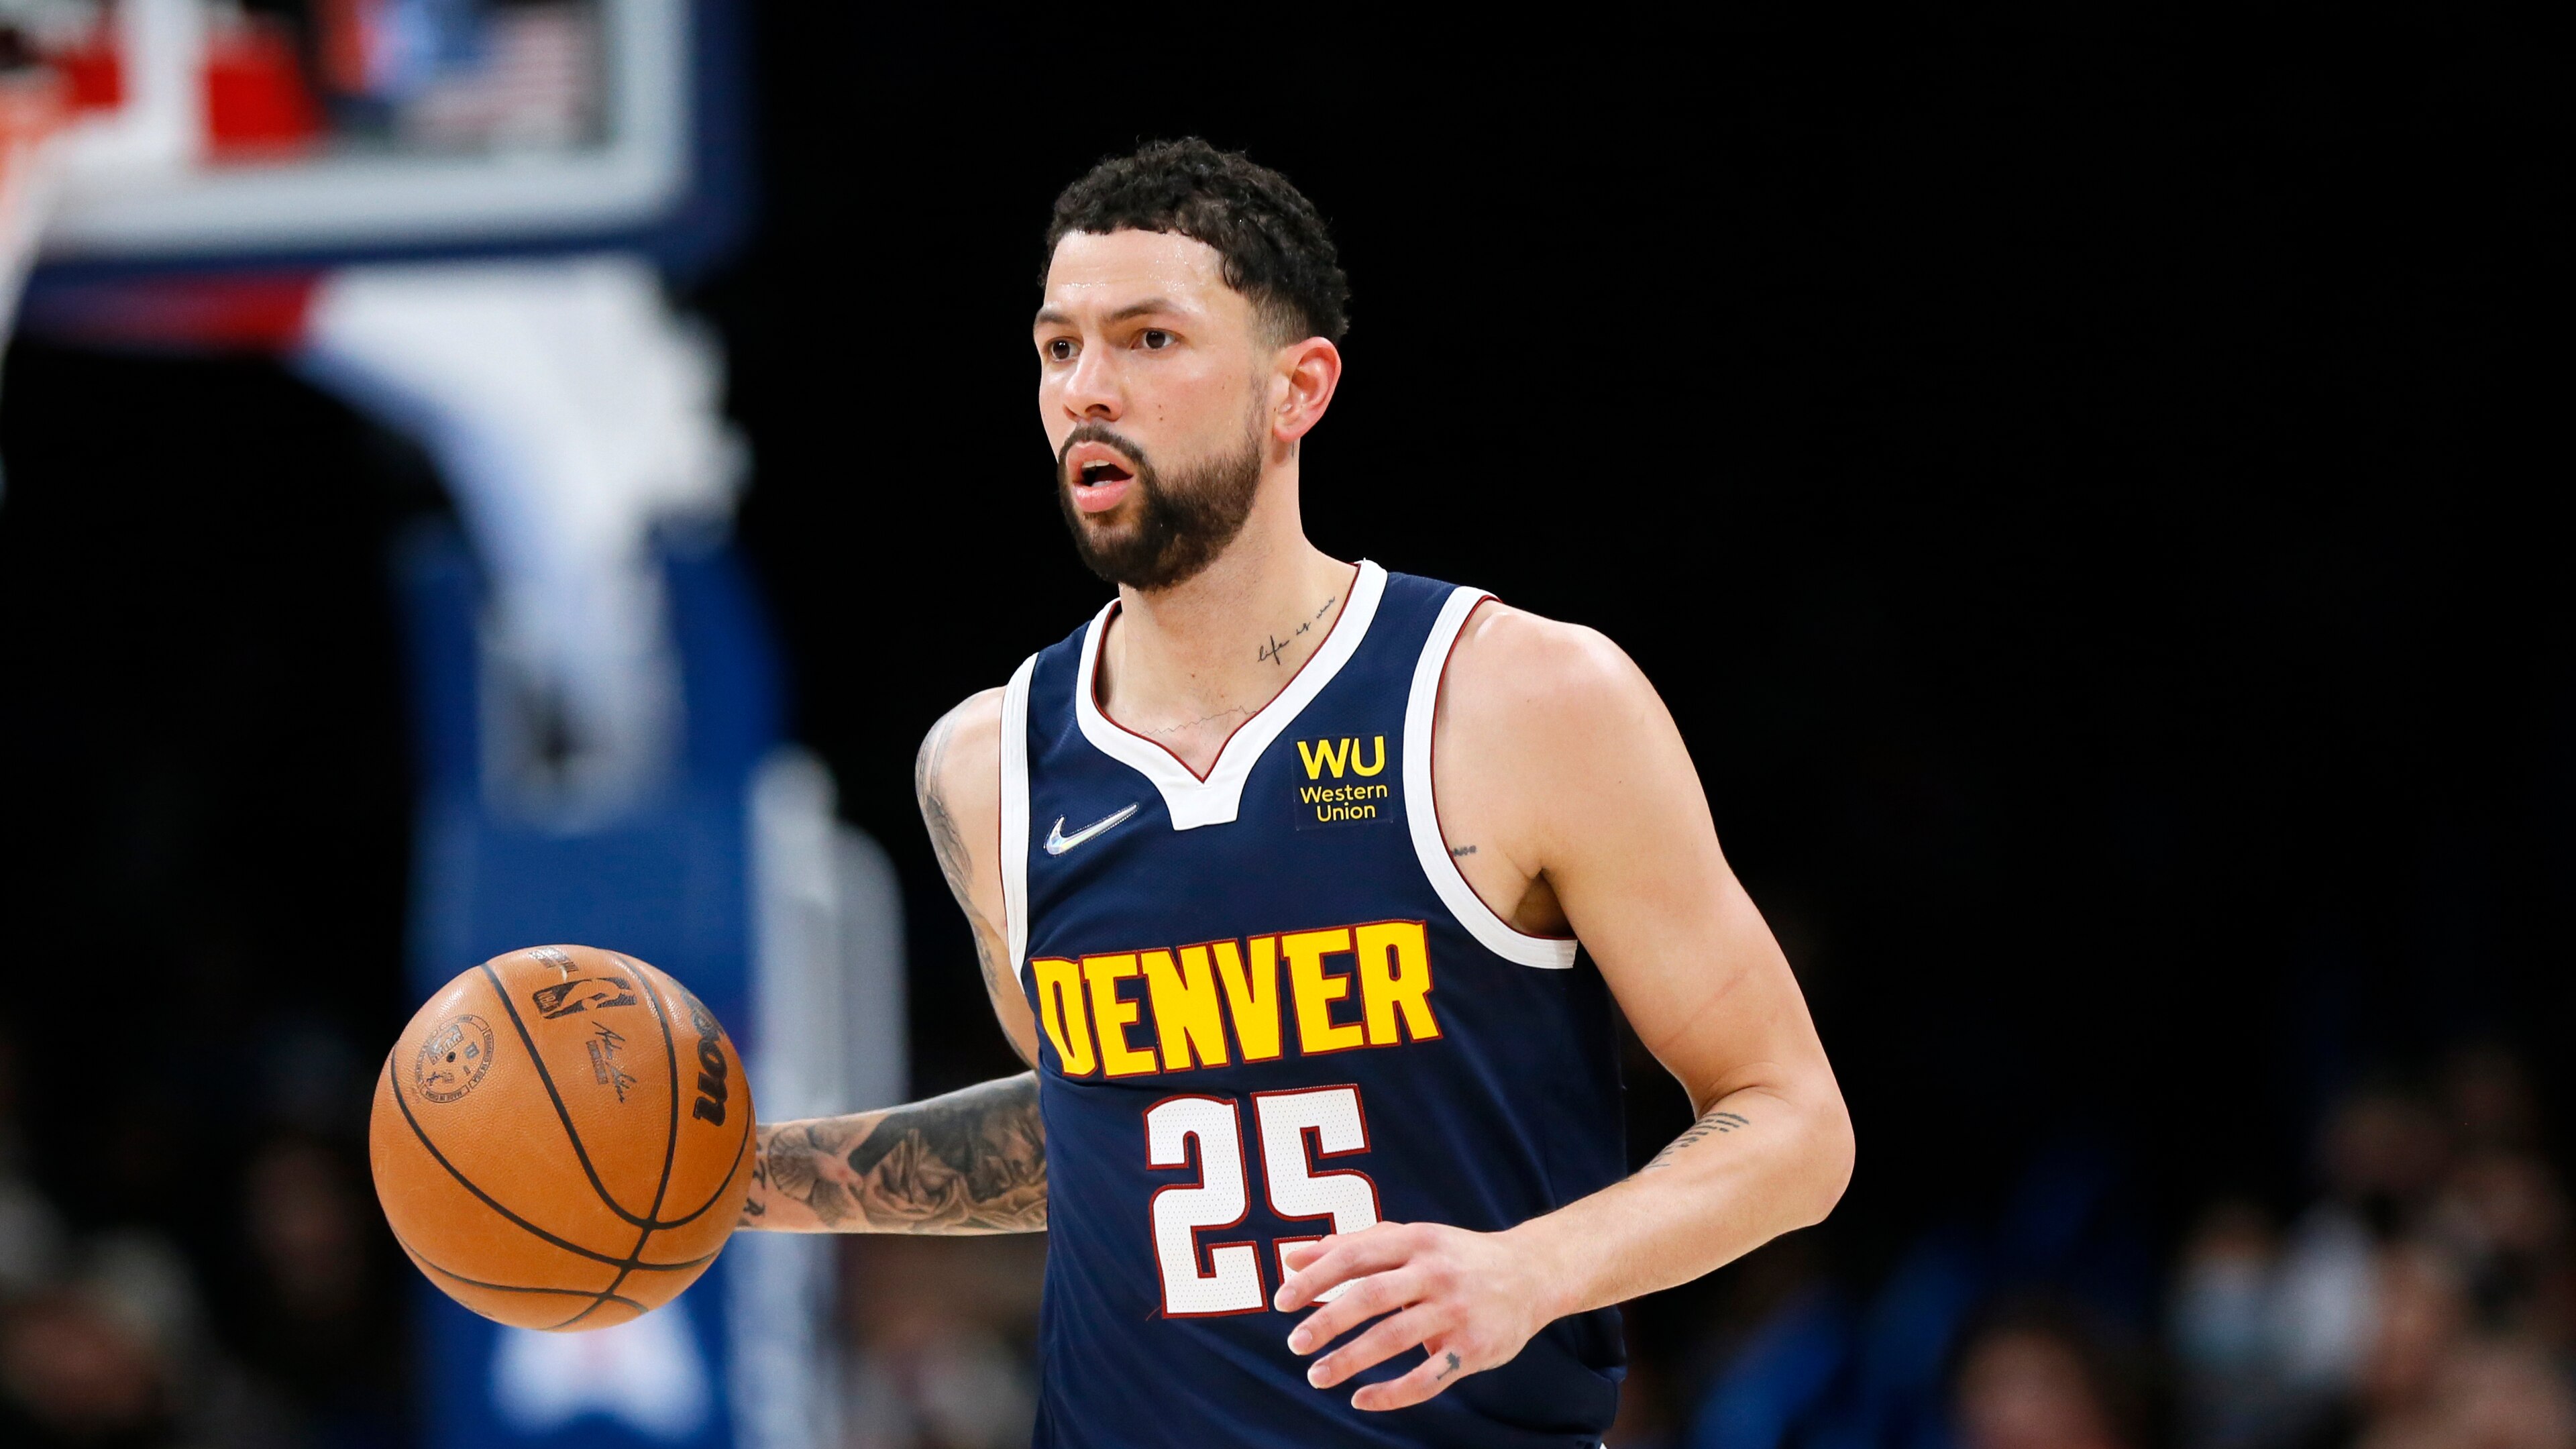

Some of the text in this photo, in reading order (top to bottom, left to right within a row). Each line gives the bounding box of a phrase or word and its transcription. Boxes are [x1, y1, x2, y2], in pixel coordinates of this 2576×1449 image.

[1258, 635, 1290, 665] life
[1295, 621, 1311, 635] is
[1297, 735, 1385, 780] WU
[1300, 784, 1388, 804] Western
[1317, 802, 1376, 822] Union
[1031, 920, 1443, 1078] DENVER
[1144, 1084, 1383, 1318] 25
